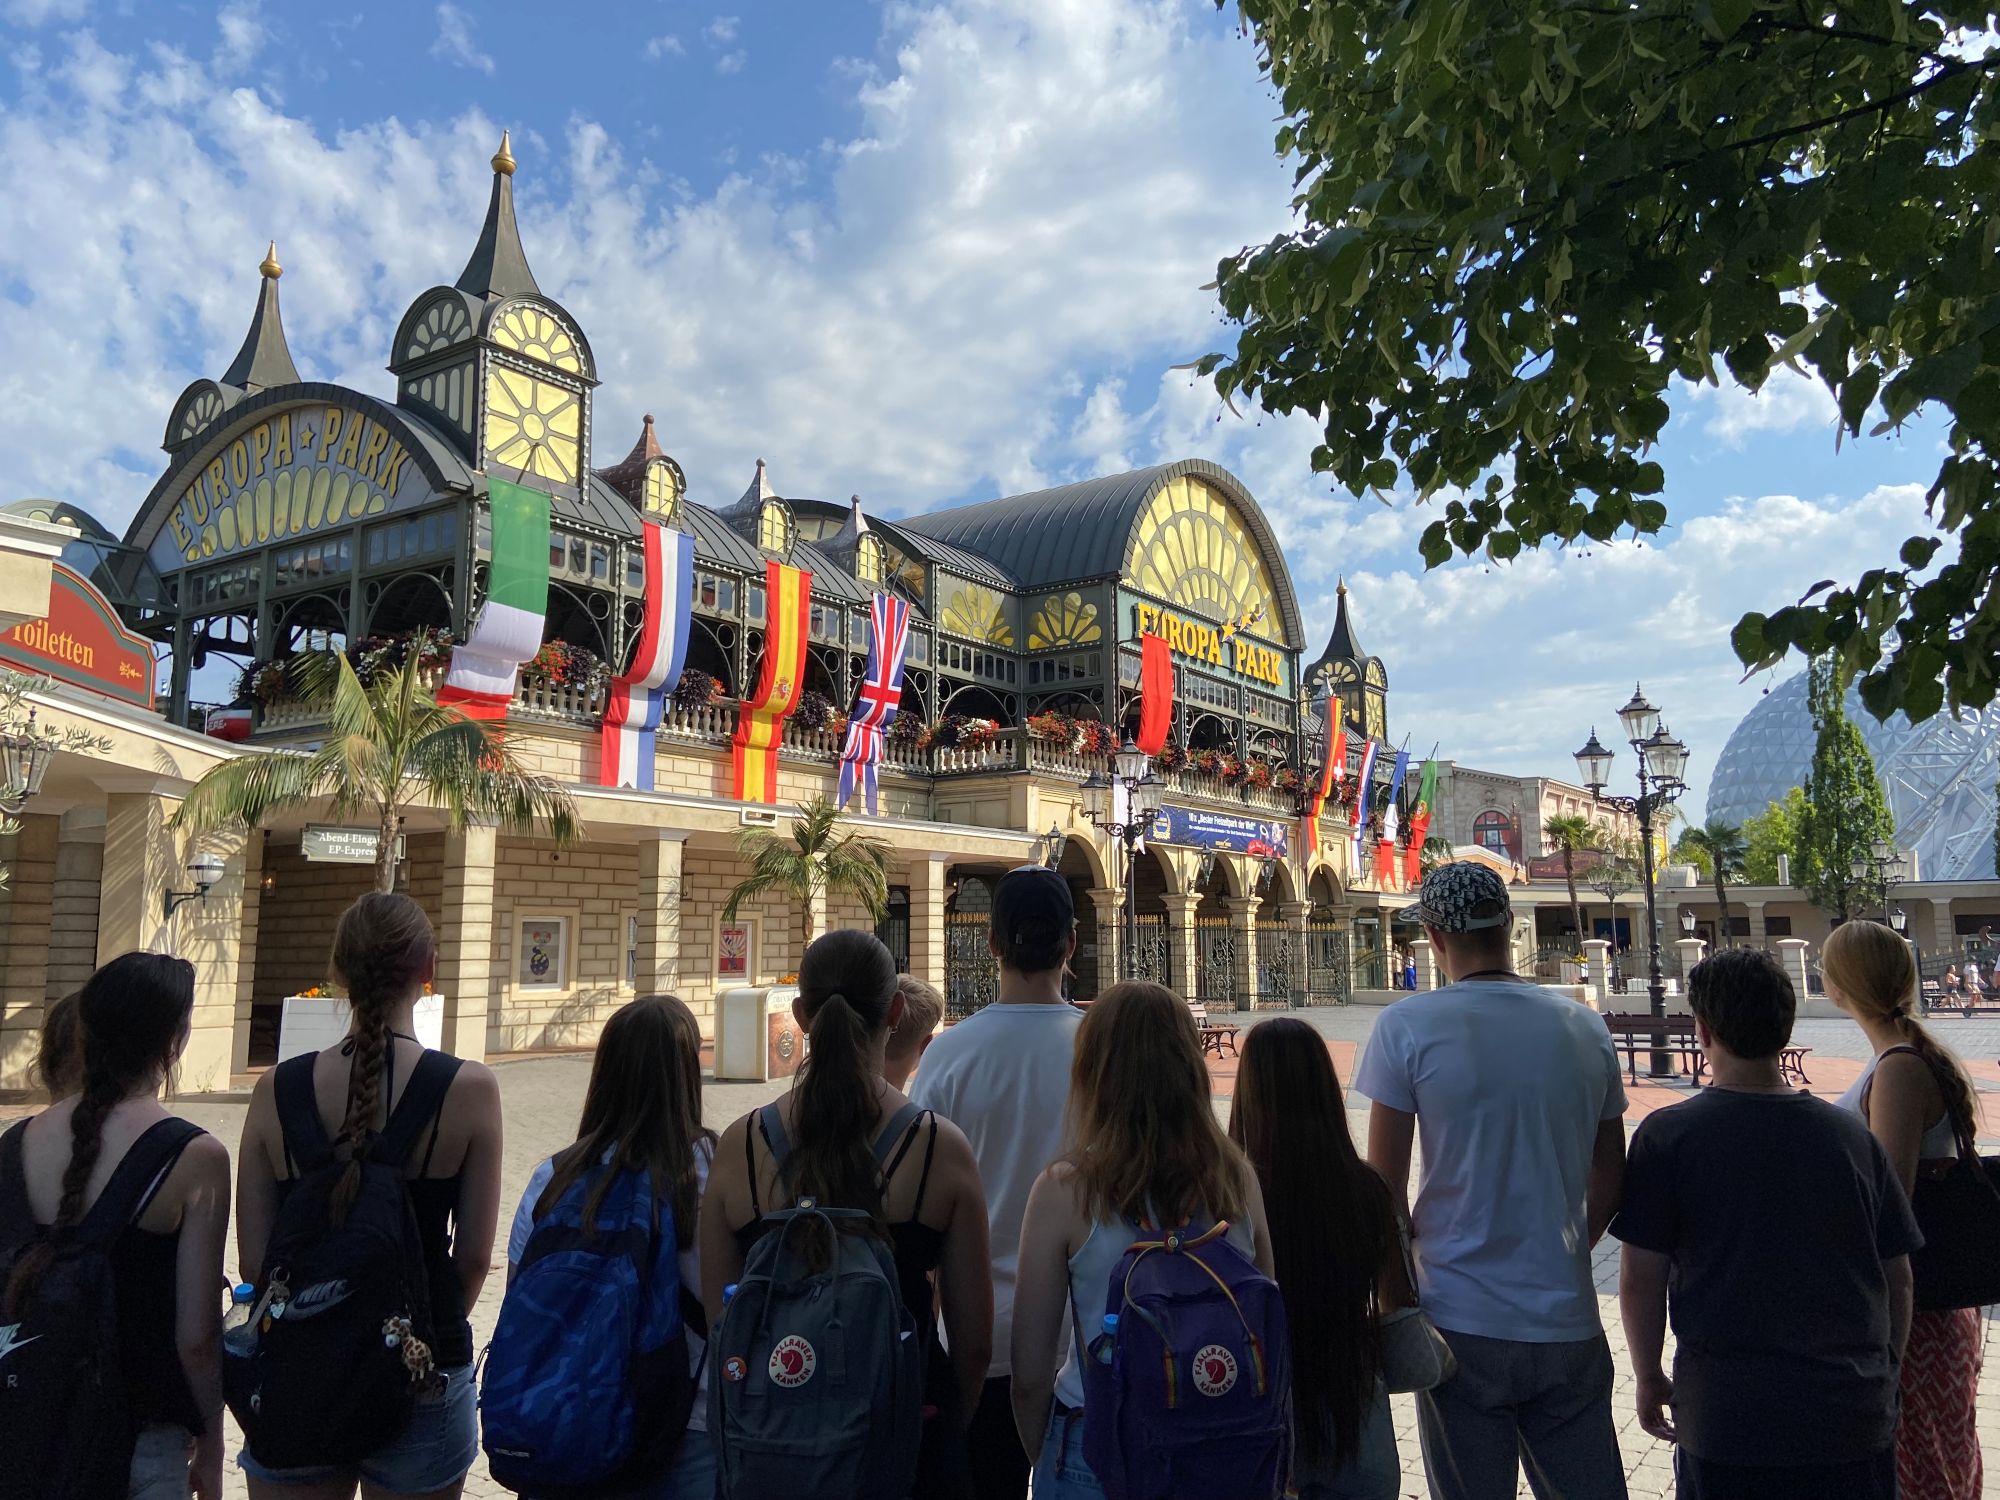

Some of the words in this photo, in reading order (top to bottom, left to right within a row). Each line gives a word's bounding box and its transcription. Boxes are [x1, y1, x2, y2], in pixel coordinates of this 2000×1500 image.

[168, 413, 293, 552] EUROPA
[318, 407, 411, 498] PARK
[1136, 602, 1223, 666] EUROPA
[1235, 639, 1283, 686] PARK
[319, 832, 380, 846] Abend-Einga
